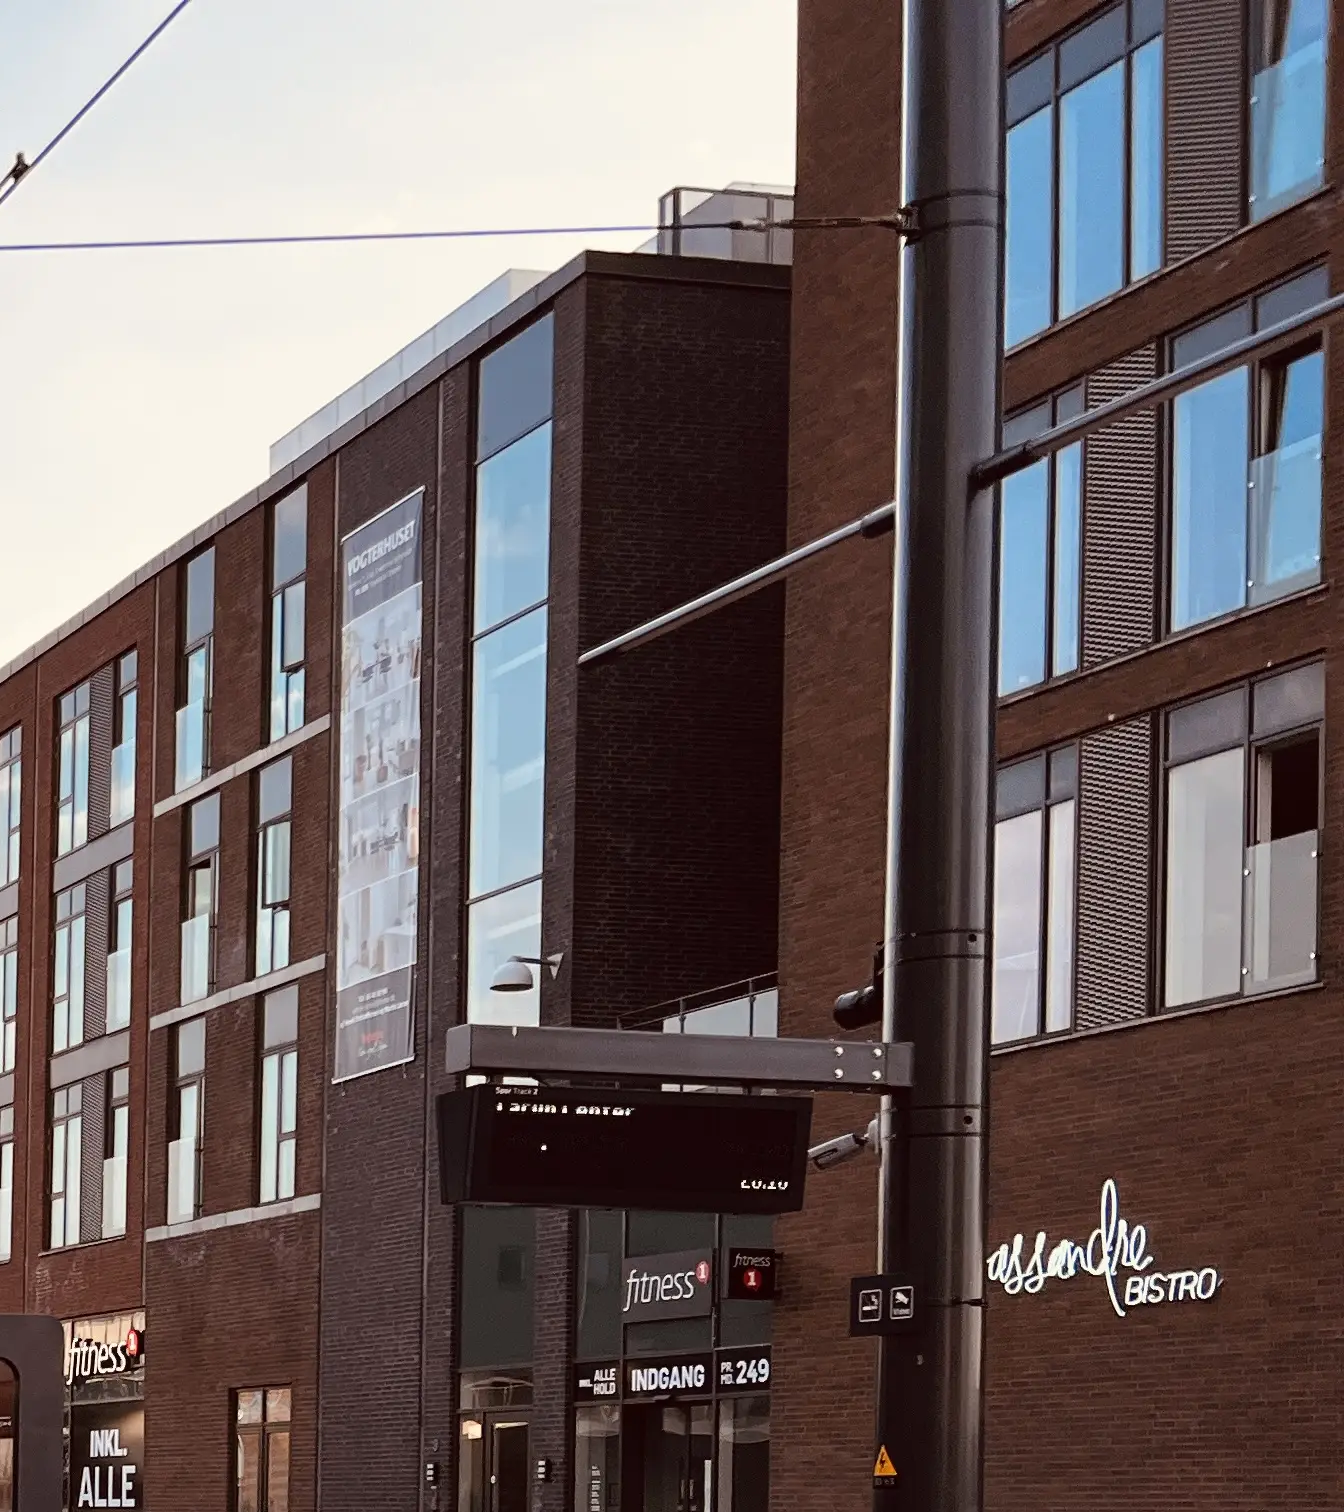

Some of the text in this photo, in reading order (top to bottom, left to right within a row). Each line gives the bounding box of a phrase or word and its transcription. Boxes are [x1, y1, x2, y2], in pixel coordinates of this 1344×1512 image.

[348, 520, 415, 576] VOGTERHUSET
[733, 1253, 771, 1268] fitness
[986, 1178, 1153, 1317] assandre
[623, 1269, 695, 1312] fitness
[747, 1271, 756, 1286] 1
[1124, 1267, 1217, 1306] BISTRO
[66, 1337, 127, 1386] fitness
[594, 1368, 616, 1381] ALLE
[721, 1362, 733, 1373] PR.
[736, 1358, 770, 1384] 249
[594, 1382, 616, 1395] HOLD
[631, 1364, 705, 1392] INDGANG
[90, 1429, 127, 1458] INKL.
[78, 1465, 136, 1507] ALLE
